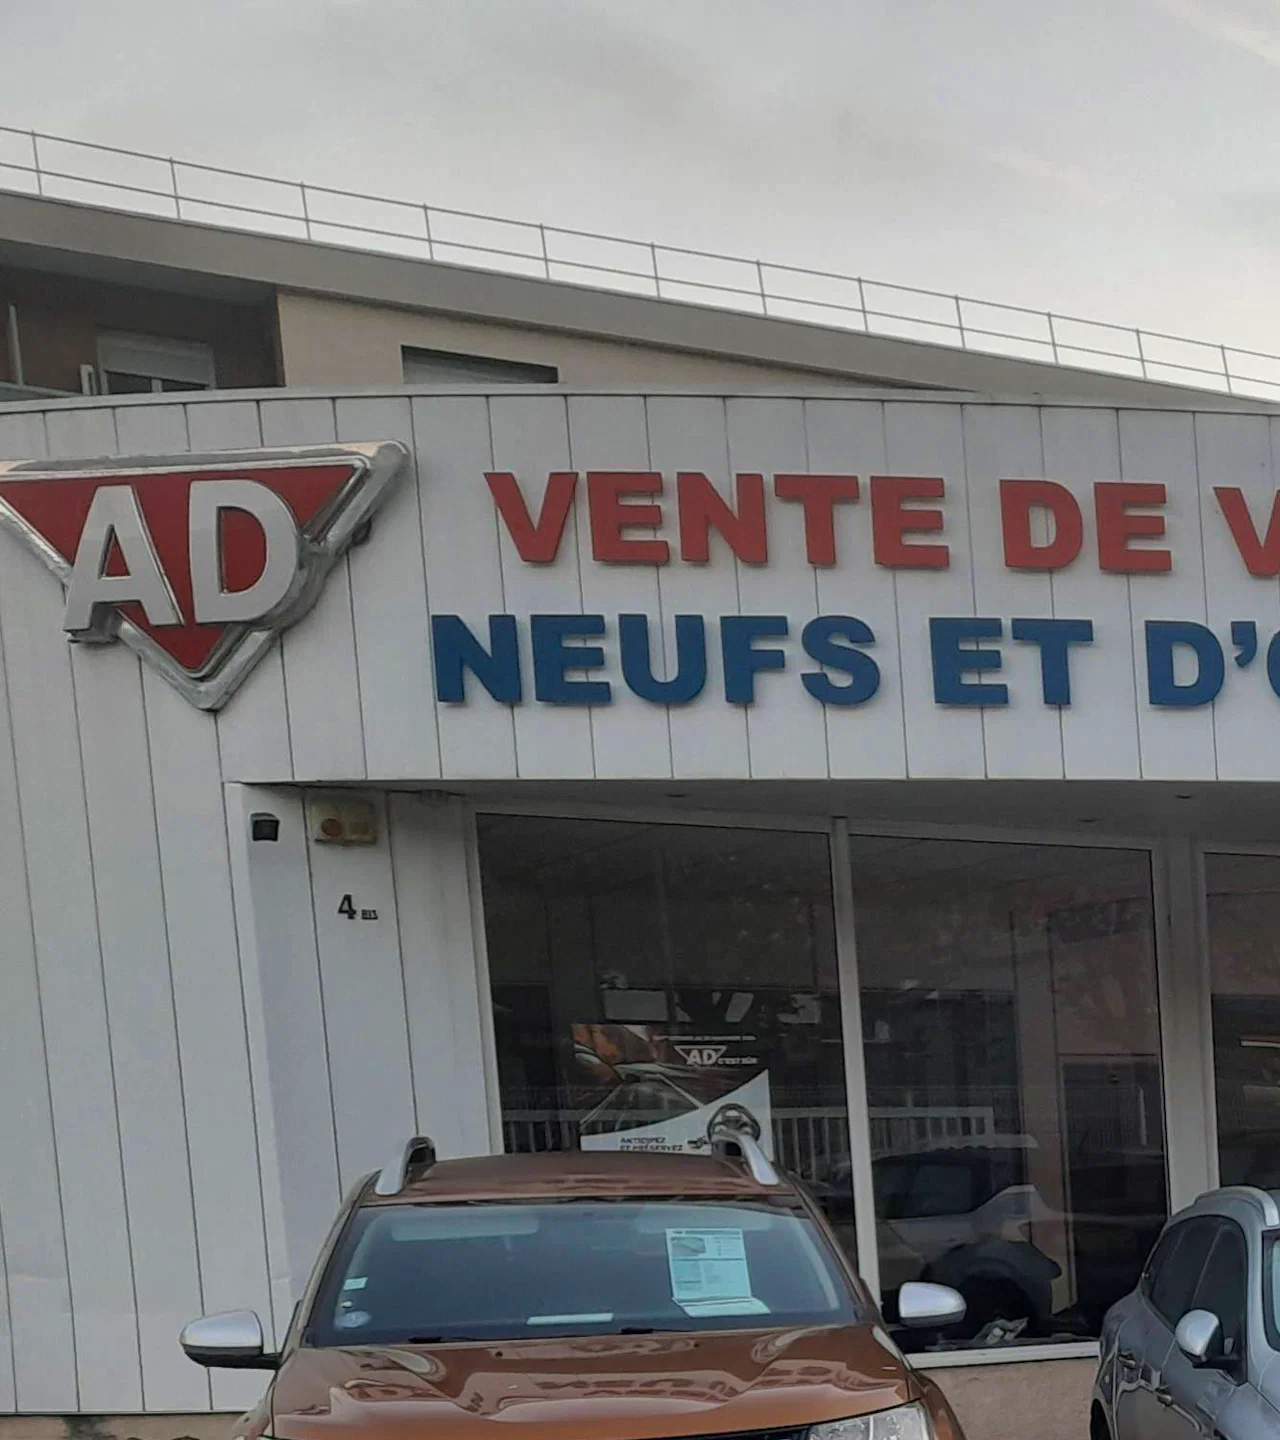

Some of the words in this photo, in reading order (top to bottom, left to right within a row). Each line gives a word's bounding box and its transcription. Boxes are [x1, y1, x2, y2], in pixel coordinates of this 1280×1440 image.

[63, 478, 302, 635] AD
[484, 471, 952, 569] VENTE
[998, 478, 1174, 574] DE
[431, 613, 882, 706] NEUFS
[927, 616, 1095, 707] ET
[338, 894, 356, 920] 4
[687, 1049, 717, 1065] AD
